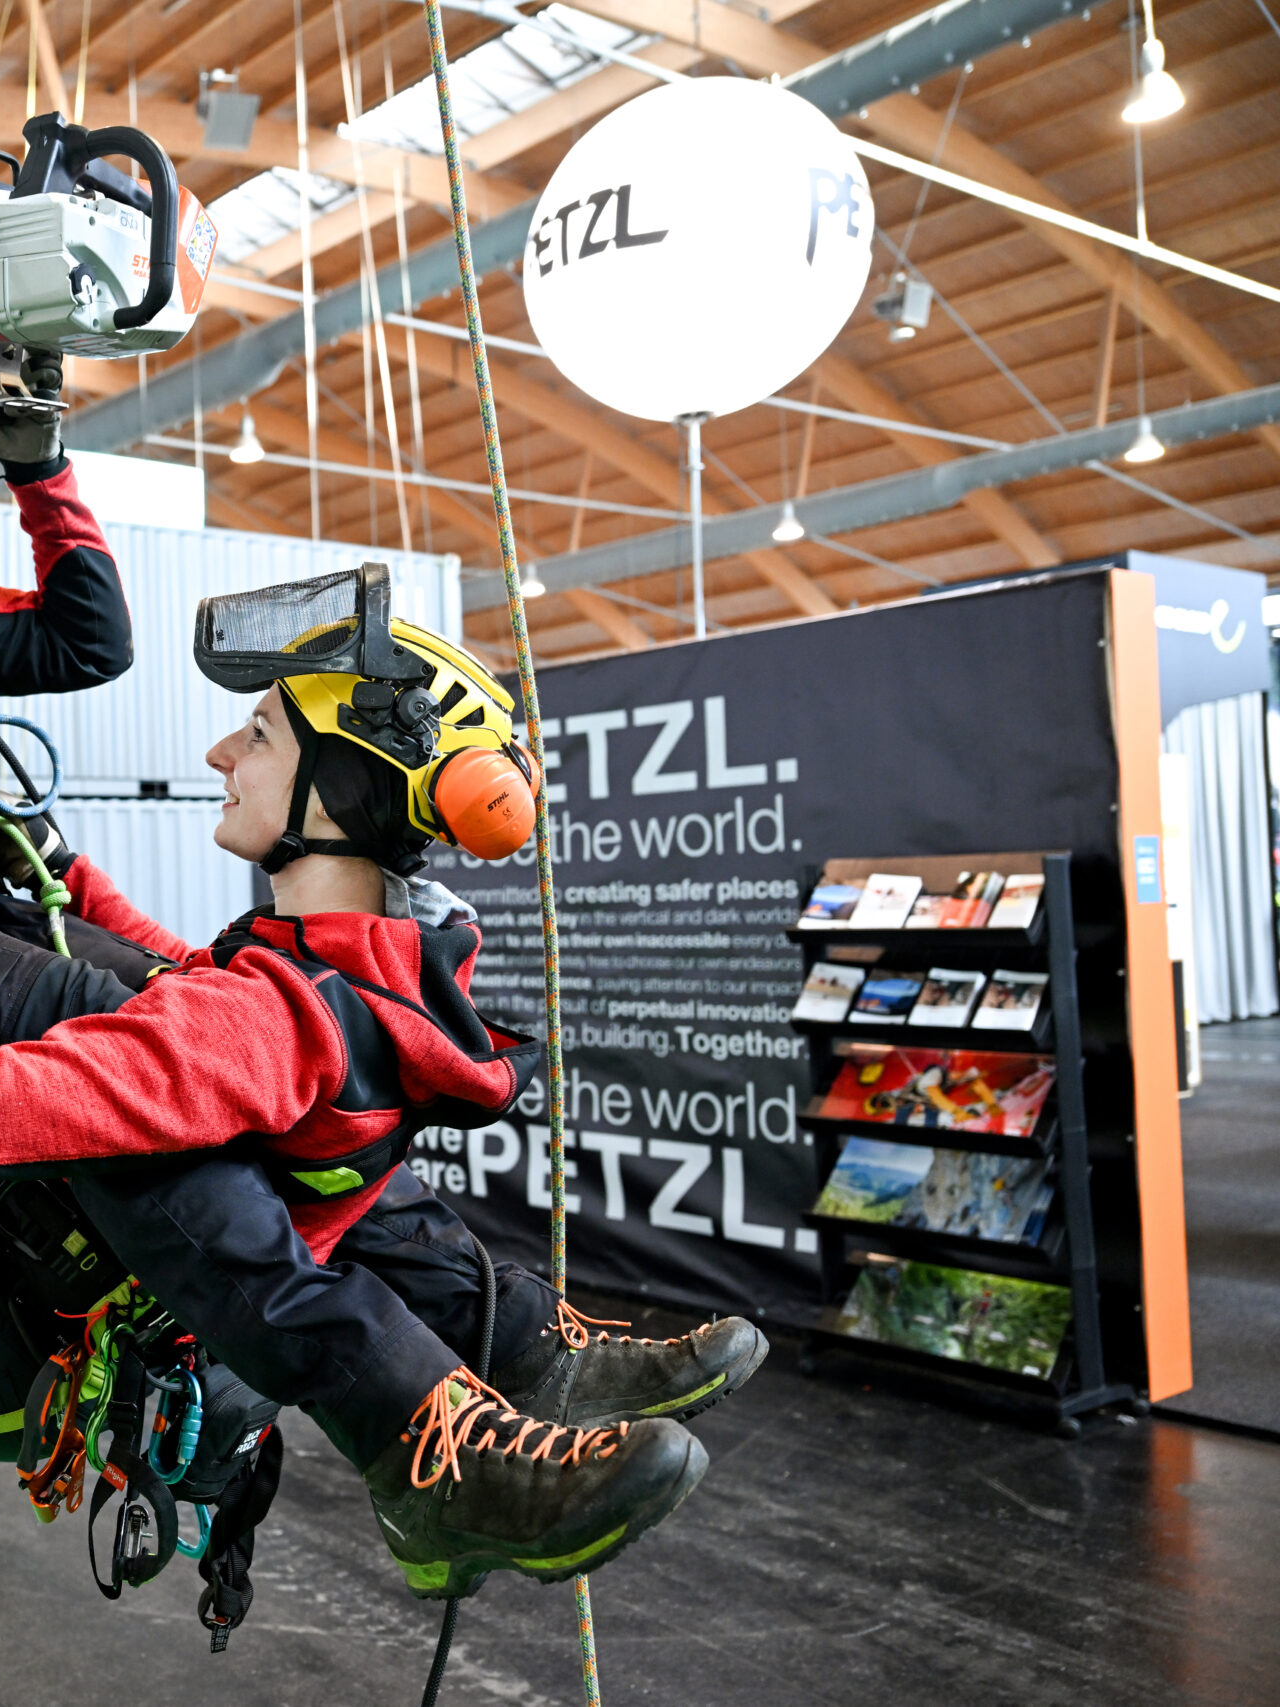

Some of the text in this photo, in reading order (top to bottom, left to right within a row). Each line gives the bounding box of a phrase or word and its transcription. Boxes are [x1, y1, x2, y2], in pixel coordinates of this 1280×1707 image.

[532, 184, 669, 277] ETZL
[515, 696, 799, 802] ETZL.
[487, 791, 509, 812] STIHL
[630, 793, 802, 860] world.
[564, 880, 651, 907] creating
[655, 878, 714, 903] safer
[716, 876, 799, 905] places
[704, 906, 741, 925] dark
[744, 905, 800, 925] worlds
[608, 999, 695, 1021] perpetual
[697, 1000, 792, 1024] innovatio
[674, 1025, 810, 1061] Together.
[641, 1081, 814, 1146] world.
[410, 1119, 818, 1254] are PETZL.
[106, 1465, 124, 1484] Right
